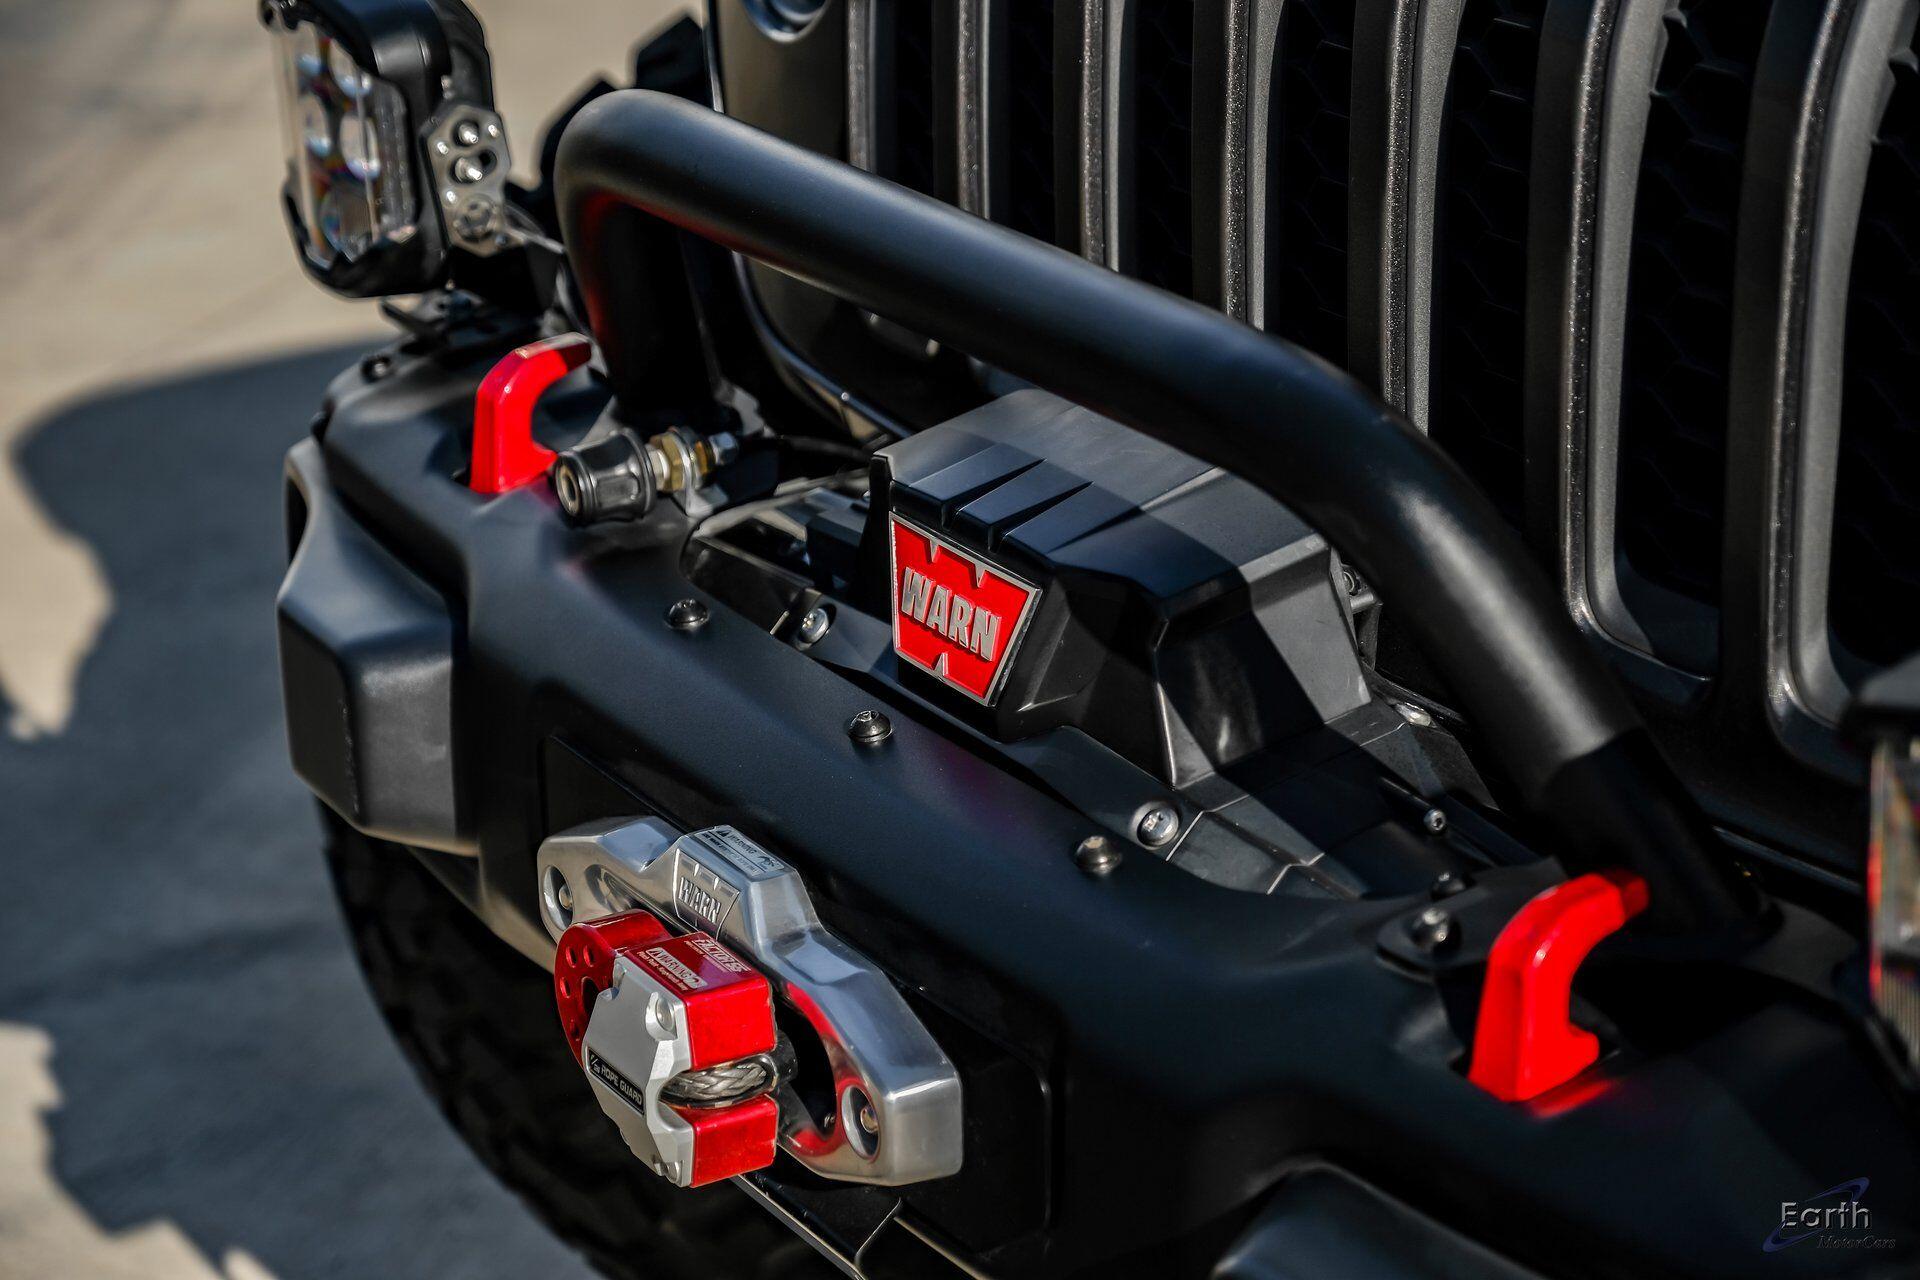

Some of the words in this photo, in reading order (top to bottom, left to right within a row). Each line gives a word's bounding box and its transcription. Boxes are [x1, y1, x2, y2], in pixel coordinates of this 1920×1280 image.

[901, 566, 1001, 662] WARN
[679, 876, 721, 925] WARN
[601, 1064, 619, 1087] ROPE
[620, 1081, 643, 1106] GUARD
